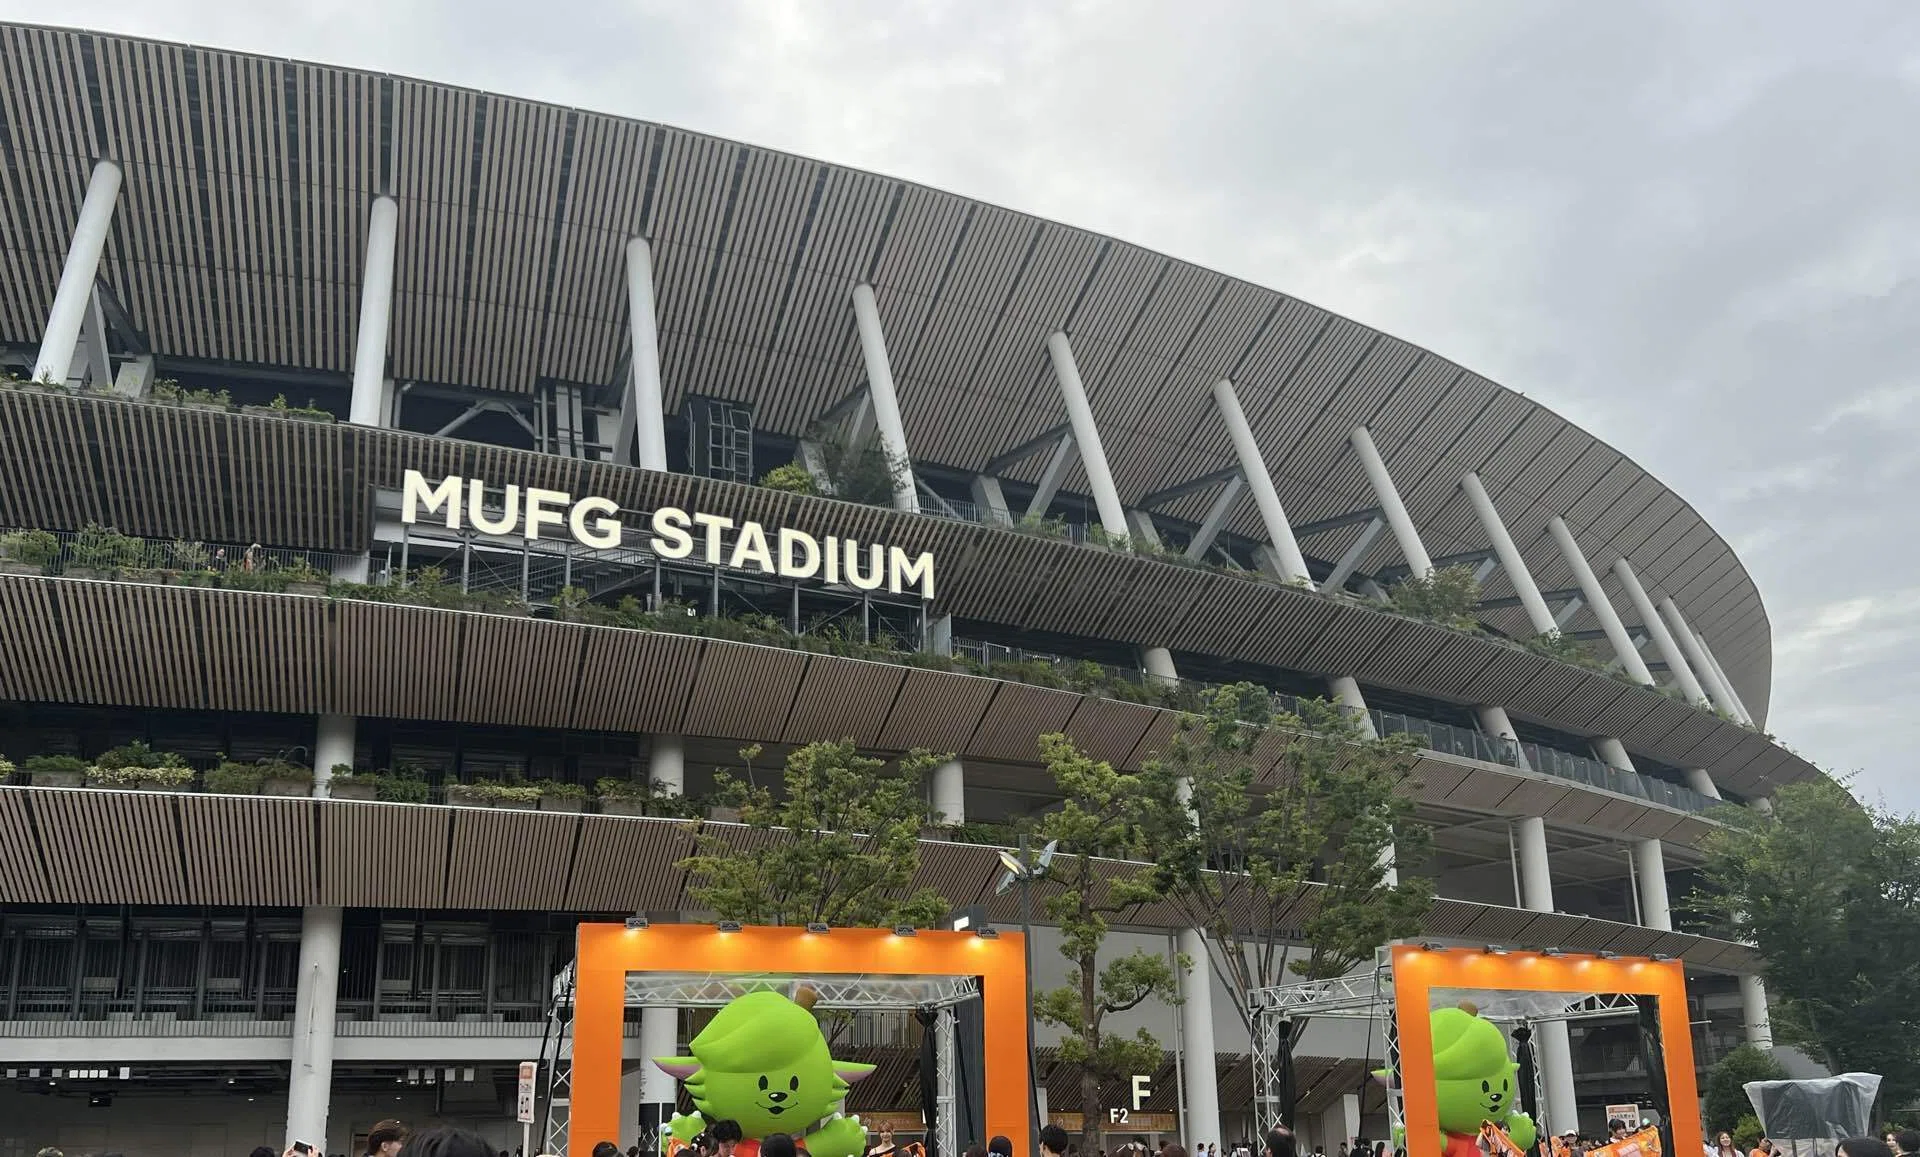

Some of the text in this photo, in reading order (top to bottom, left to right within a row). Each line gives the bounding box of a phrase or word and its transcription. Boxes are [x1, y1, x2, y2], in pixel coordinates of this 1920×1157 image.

[402, 469, 936, 600] MUFG STADIUM
[1132, 1075, 1151, 1111] F
[1110, 1108, 1129, 1124] F2
